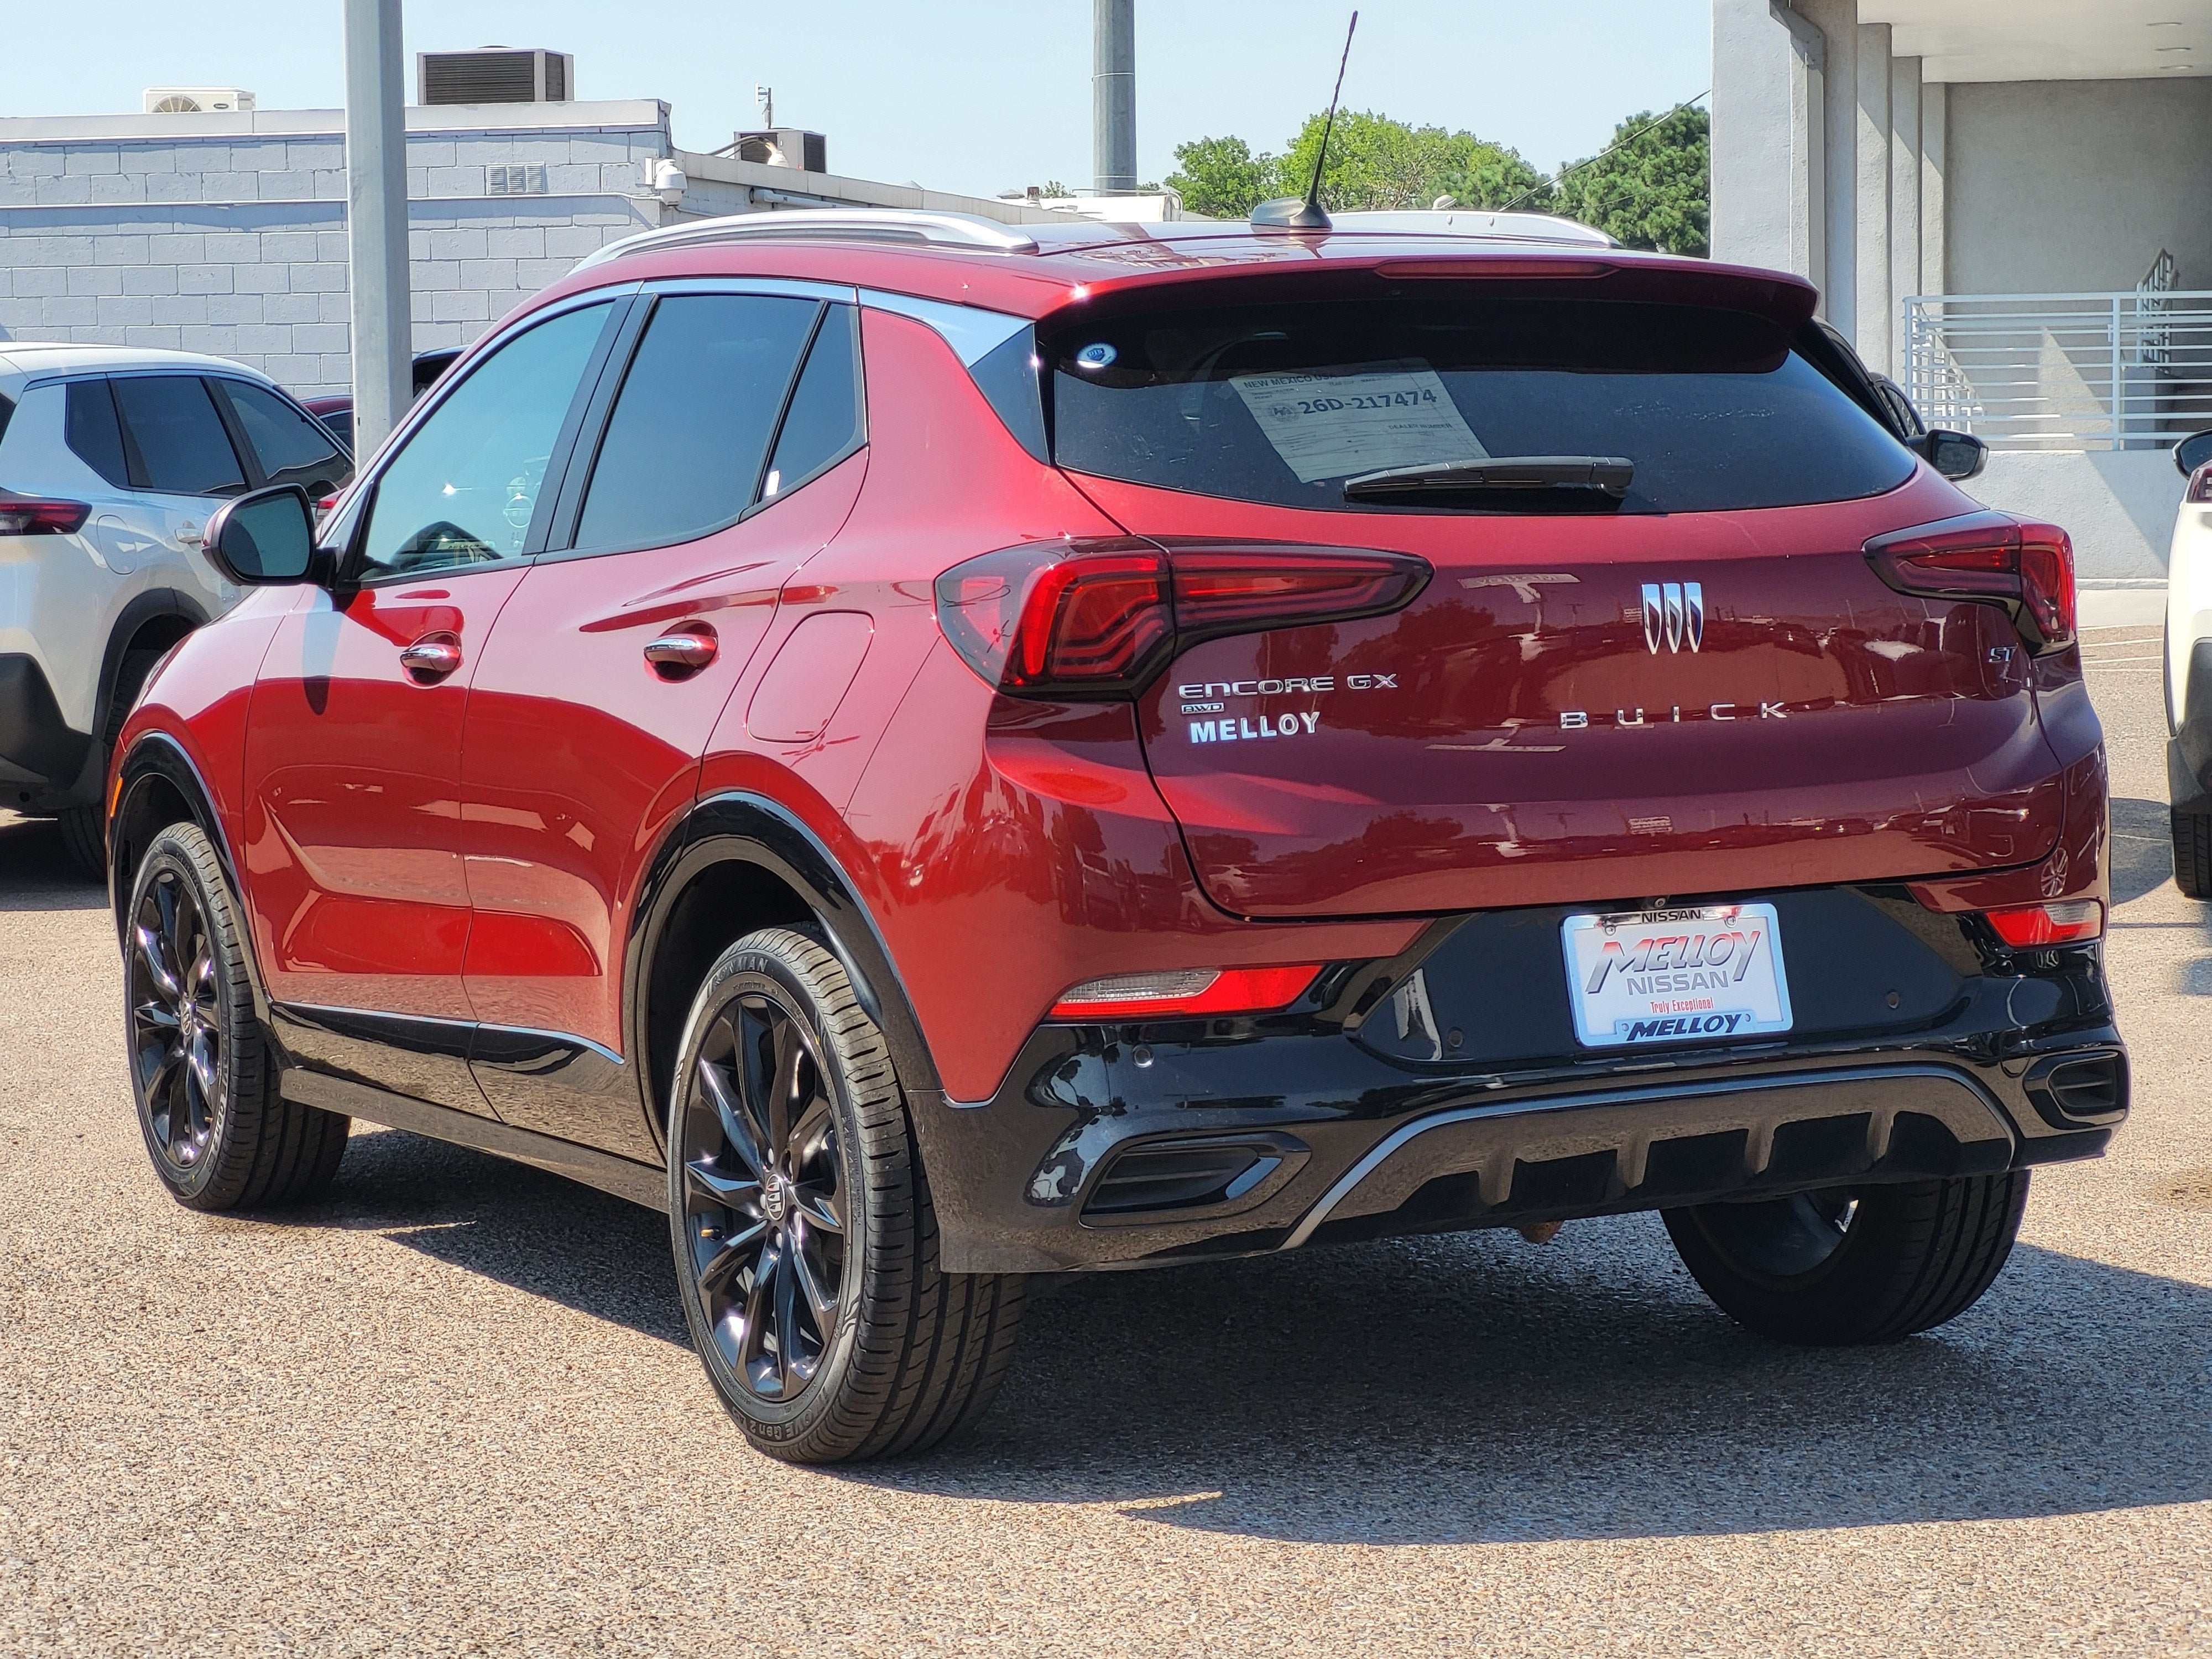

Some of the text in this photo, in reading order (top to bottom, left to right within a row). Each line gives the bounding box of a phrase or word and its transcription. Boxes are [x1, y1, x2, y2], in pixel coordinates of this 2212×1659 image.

[1244, 379, 1268, 388] NEW
[1270, 375, 1312, 385] MEXICO
[1297, 389, 1437, 415] 26D-217474
[1989, 645, 2017, 663] ST
[1178, 673, 1399, 699] ENCORE GX
[1183, 703, 1223, 713] AWD
[1559, 701, 1788, 729] BUICK
[1190, 711, 1321, 743] MELLOY
[1641, 909, 1702, 924] NISSAN
[1585, 930, 1761, 994] MELLOY
[1626, 971, 1729, 995] NISSAN
[1650, 997, 1715, 1014] Truly Exceptional
[1626, 1013, 1742, 1041] MELLOY
